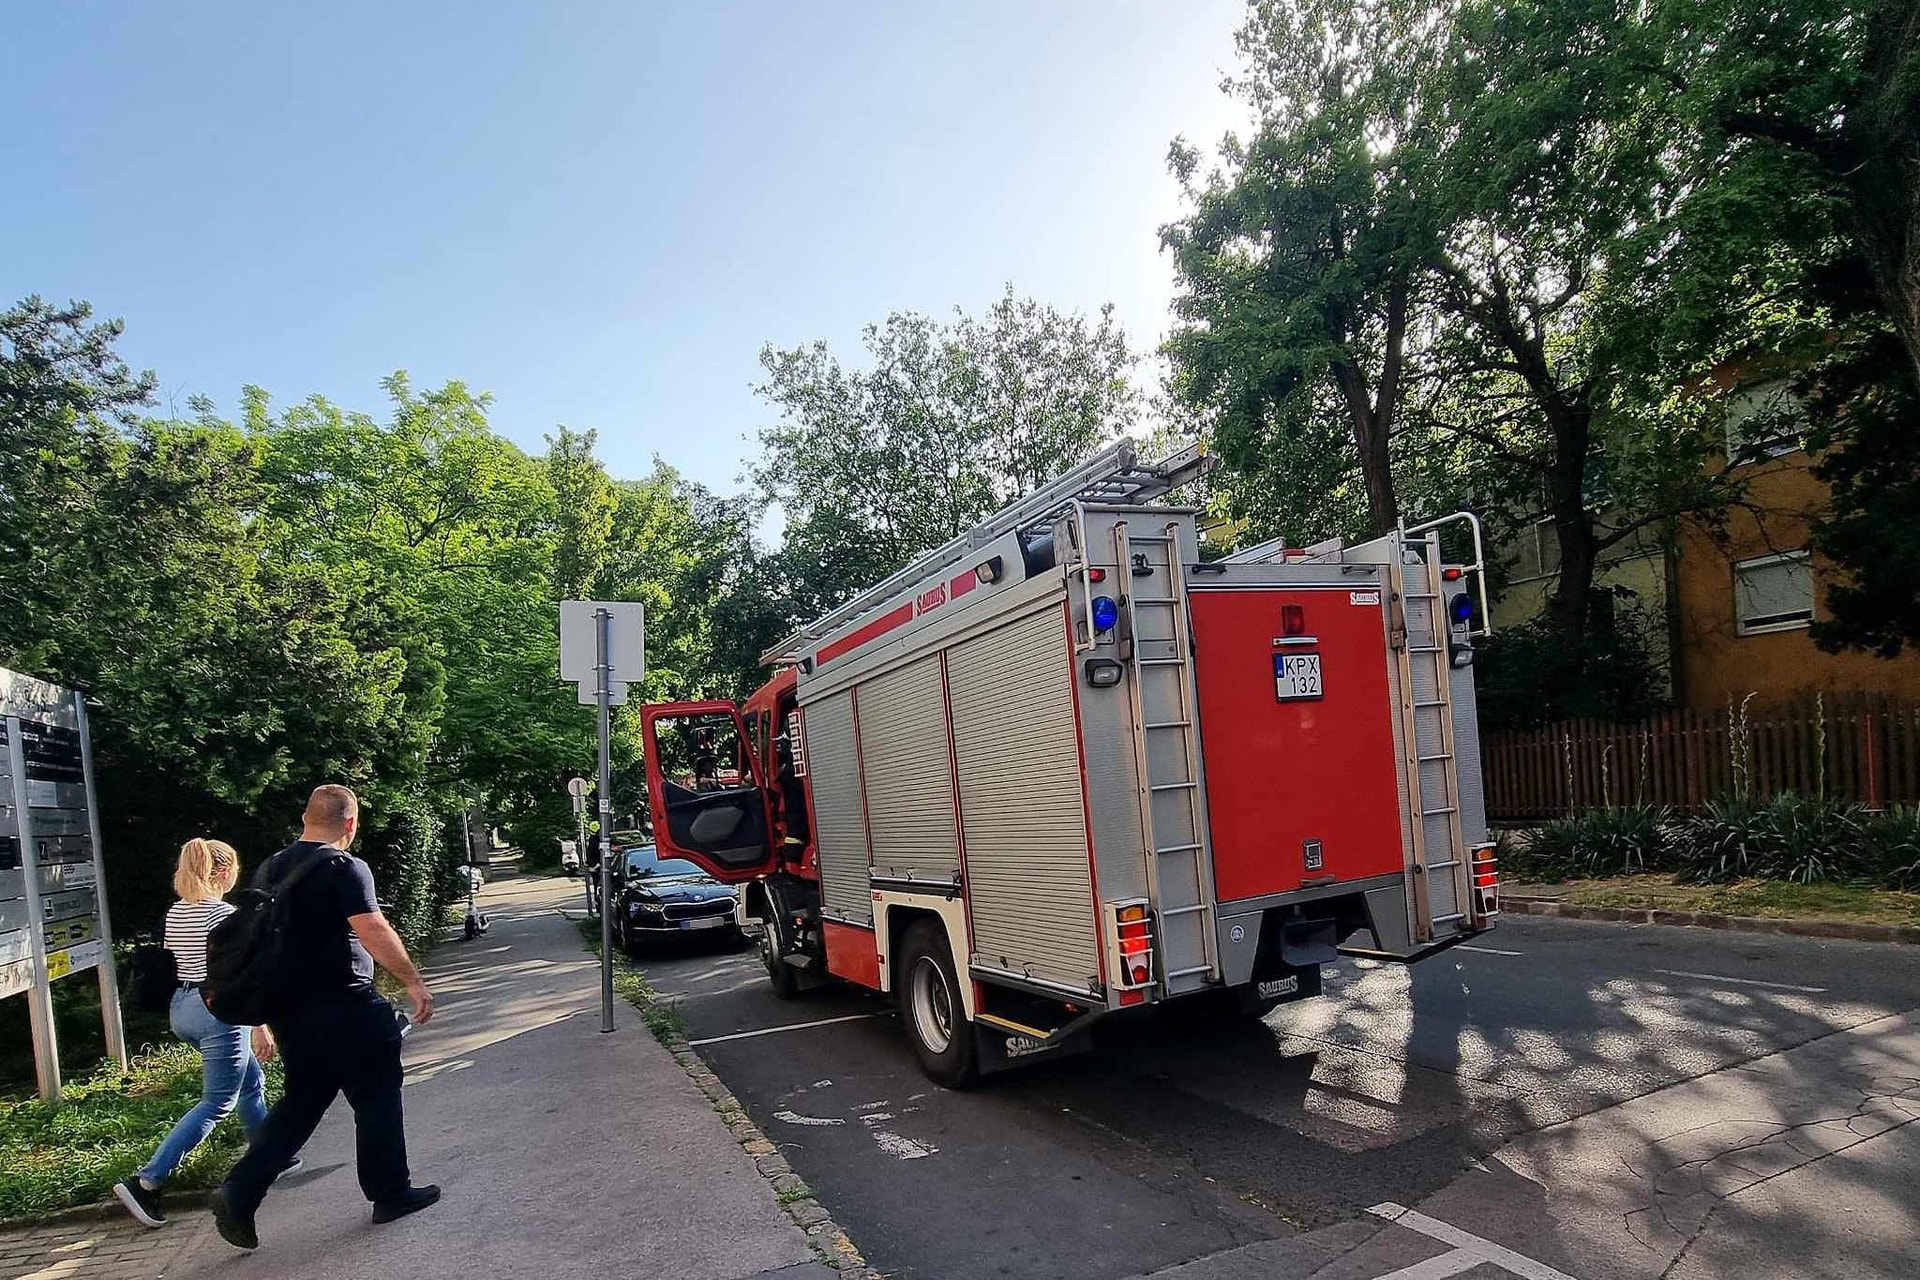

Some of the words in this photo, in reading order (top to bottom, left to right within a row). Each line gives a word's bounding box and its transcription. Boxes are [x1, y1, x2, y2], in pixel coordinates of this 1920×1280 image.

[1285, 657, 1317, 675] KPX
[1291, 676, 1317, 694] 132
[1258, 975, 1298, 1000] SAURUS
